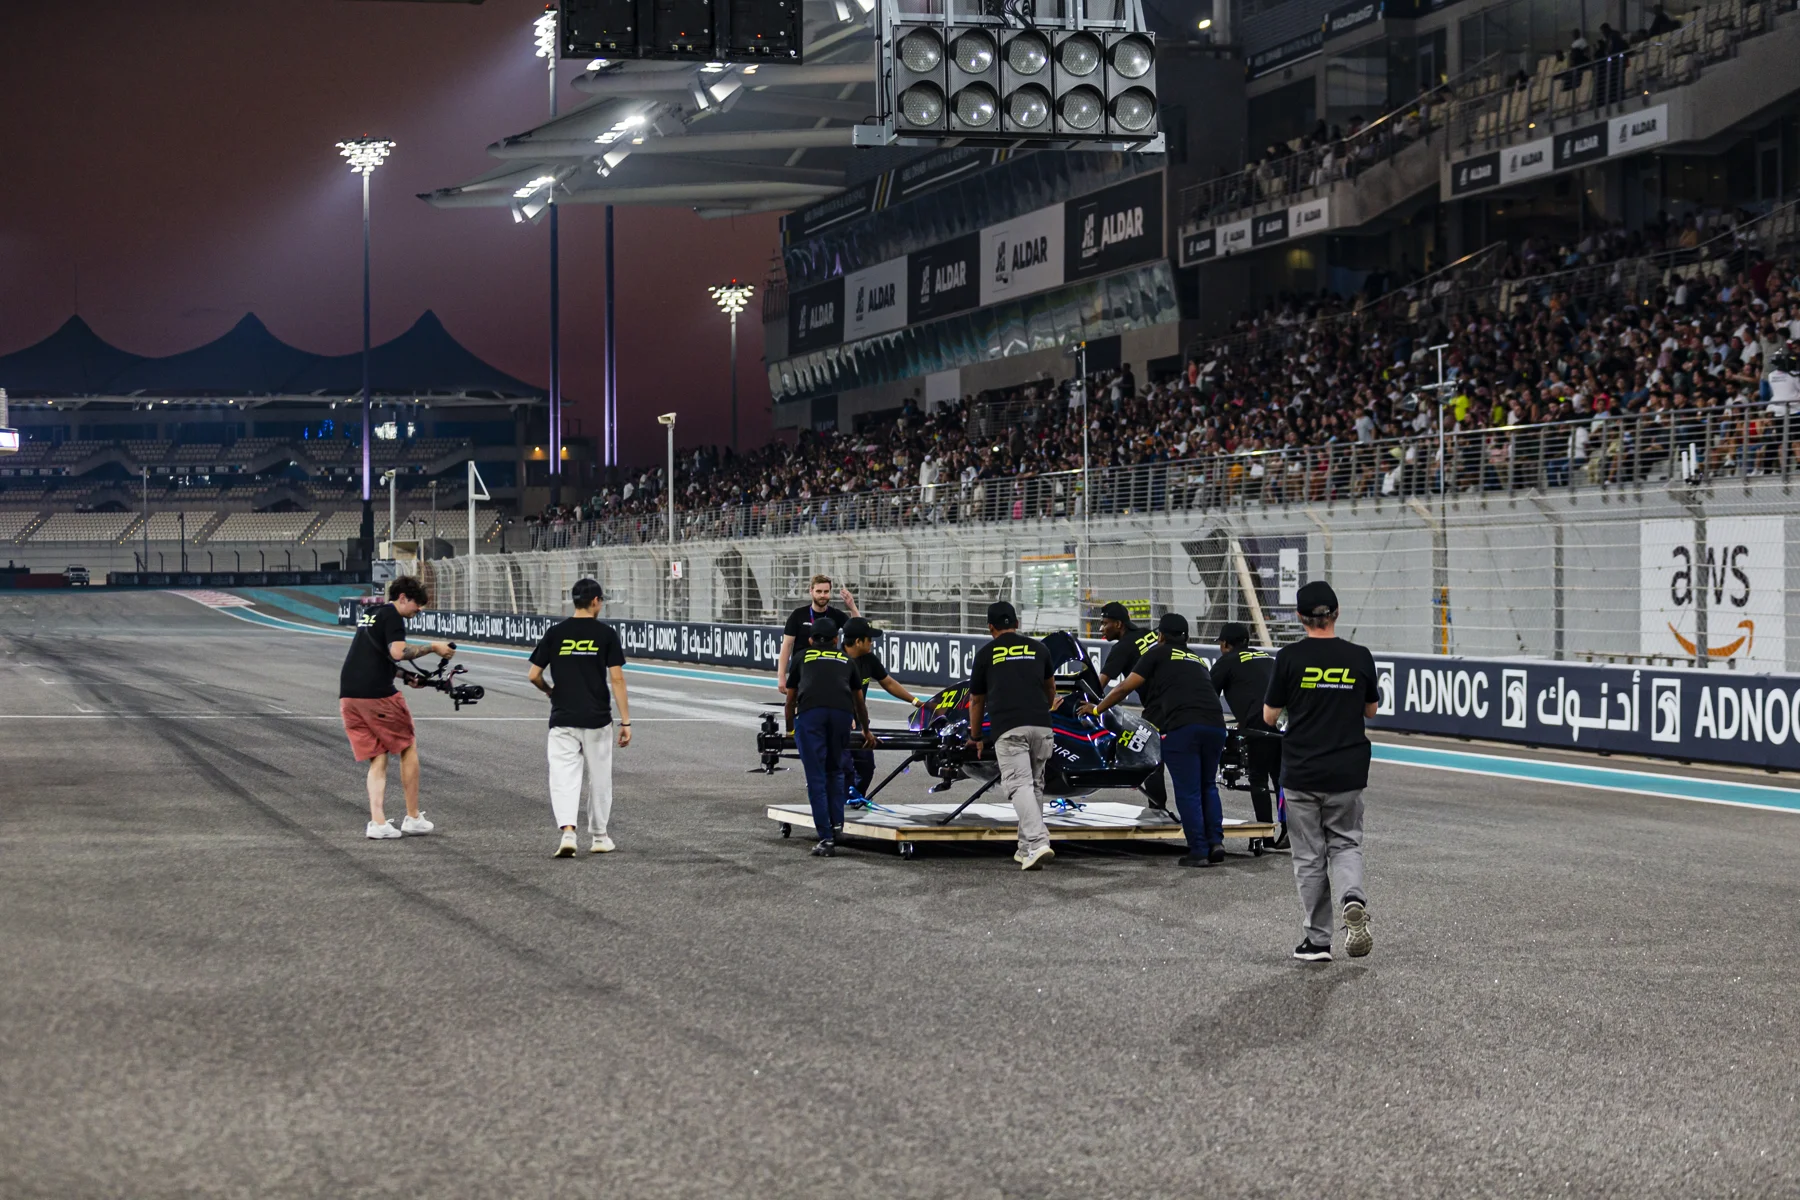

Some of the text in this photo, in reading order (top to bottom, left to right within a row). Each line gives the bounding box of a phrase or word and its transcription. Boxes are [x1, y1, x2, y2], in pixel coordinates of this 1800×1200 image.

[1101, 206, 1144, 249] ALDAR
[1012, 236, 1048, 271] ALDAR
[934, 260, 967, 294] ALDAR
[868, 283, 896, 313] ALDAR
[809, 302, 834, 329] ALDAR
[1671, 545, 1750, 607] aws
[561, 639, 600, 651] DCL
[655, 627, 677, 651] ADNOC
[689, 624, 713, 660] أدنوك
[723, 631, 748, 658] ADNOC
[993, 644, 1037, 660] DCL
[805, 649, 849, 661] DCL
[903, 641, 940, 674] ADNOC
[1302, 667, 1356, 684] DCL
[1405, 669, 1489, 720] ADNOC
[1537, 669, 1641, 742] أدنوك
[1118, 730, 1135, 747] DCL
